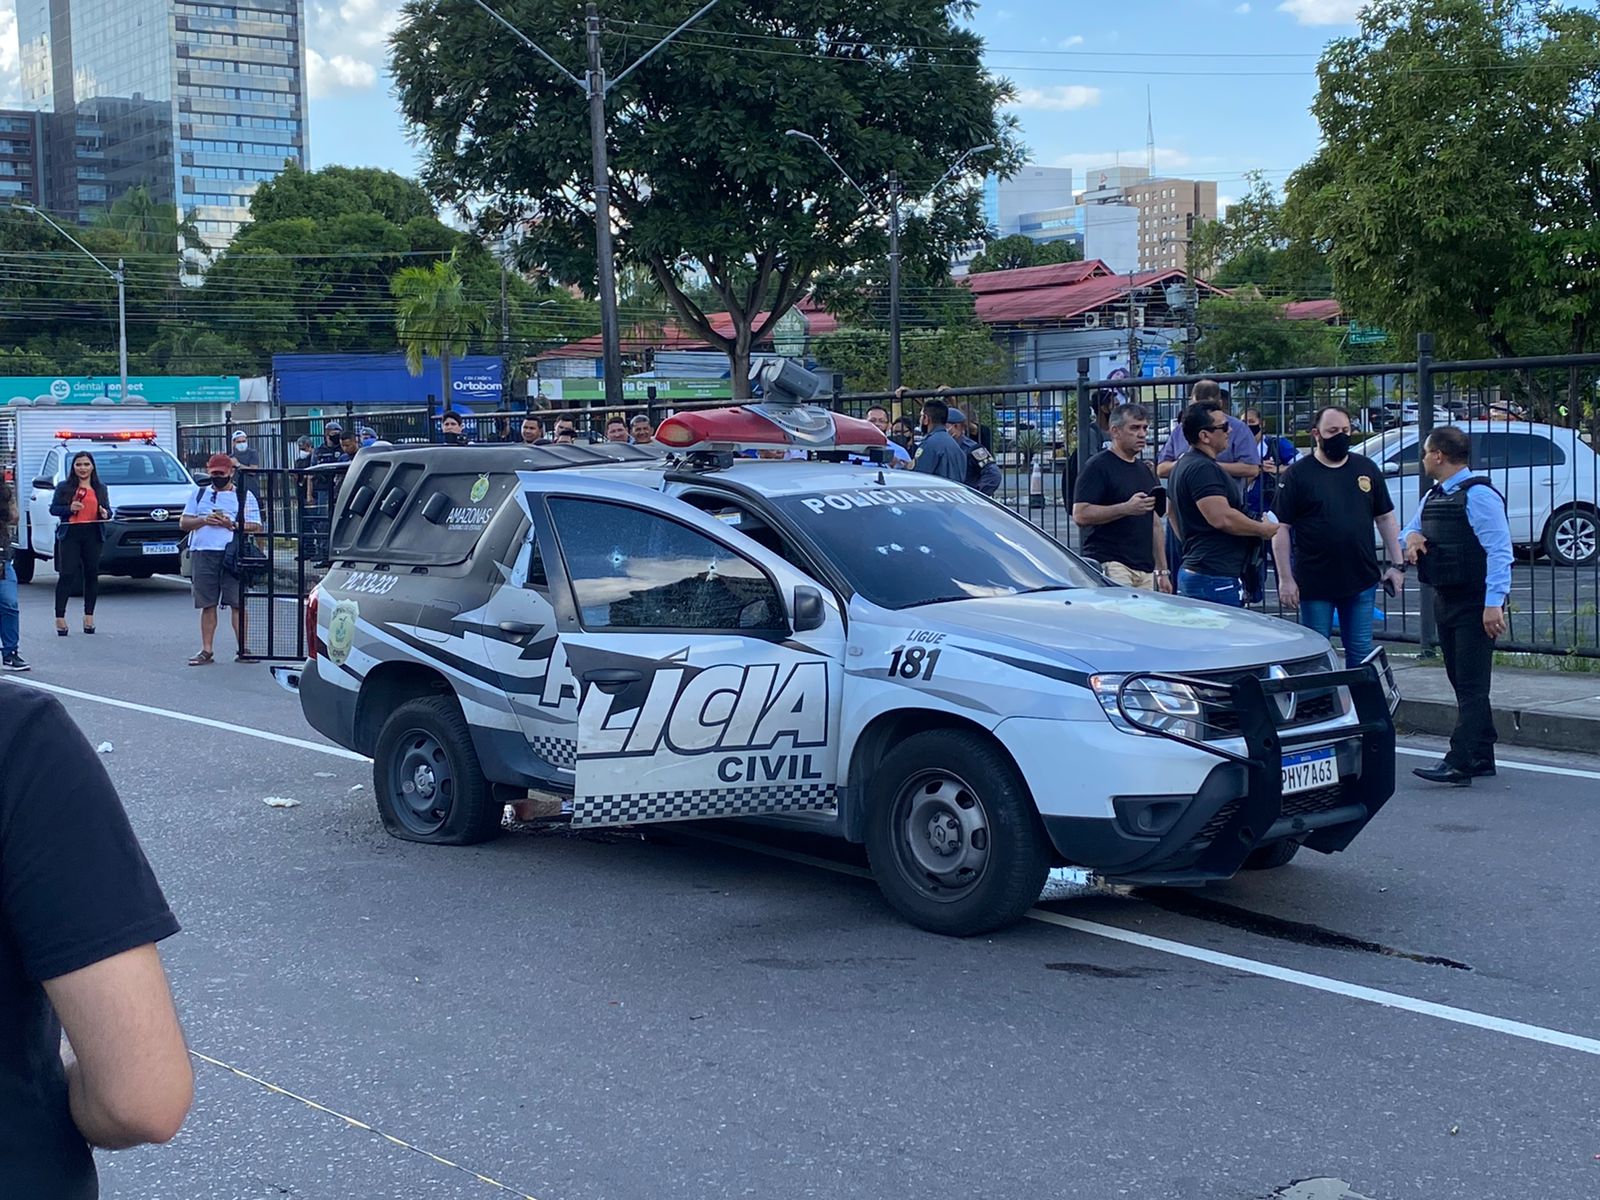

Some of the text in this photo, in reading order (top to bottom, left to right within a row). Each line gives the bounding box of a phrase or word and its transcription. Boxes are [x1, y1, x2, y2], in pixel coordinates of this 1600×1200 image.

[453, 381, 503, 390] Ortobom
[598, 381, 636, 391] Liria
[800, 489, 991, 514] POLÍCIA CIVIL
[445, 507, 493, 524] AMAZONAS
[906, 629, 947, 644] LIGUE
[887, 644, 942, 681] 181
[717, 754, 823, 783] CIVIL
[1281, 760, 1333, 791] PHY7A63
